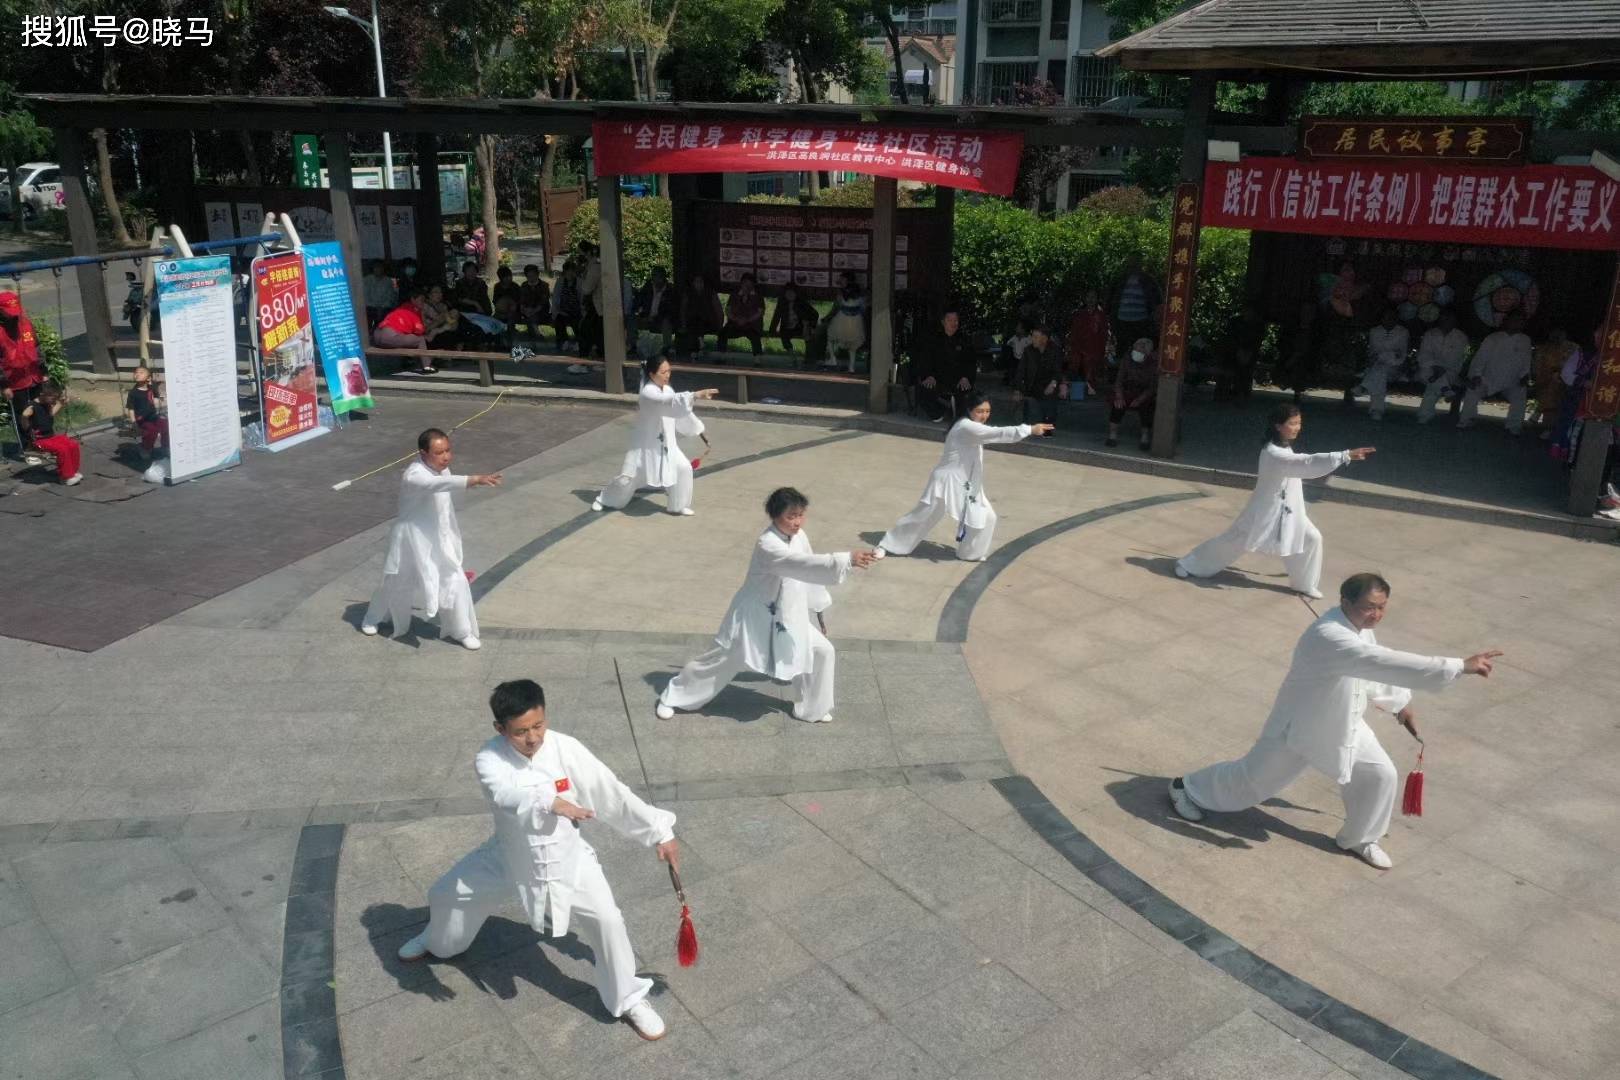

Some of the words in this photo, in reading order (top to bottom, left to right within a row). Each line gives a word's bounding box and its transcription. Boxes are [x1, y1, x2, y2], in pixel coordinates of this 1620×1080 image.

[623, 124, 725, 150] “全民健身
[740, 127, 984, 164] 科学健身”进社区活动
[1334, 126, 1488, 155] 居民议事亭
[1222, 167, 1618, 233] 践行《信访工作条例》把握群众工作要义
